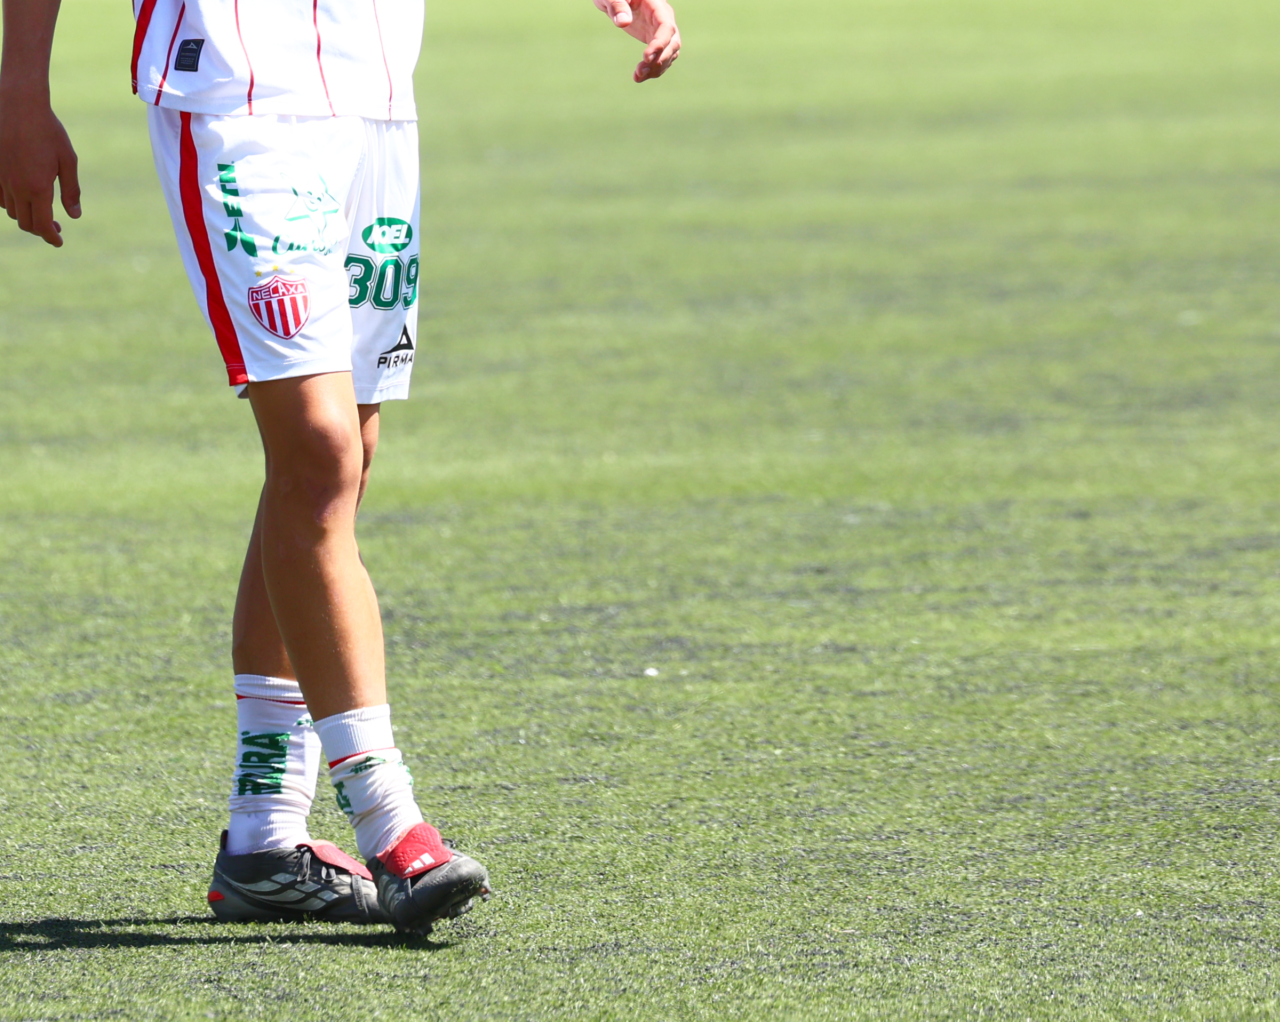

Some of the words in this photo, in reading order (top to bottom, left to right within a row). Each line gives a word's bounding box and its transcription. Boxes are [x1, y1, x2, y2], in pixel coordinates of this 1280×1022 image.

[252, 281, 307, 301] NECAXA
[344, 253, 419, 310] 309
[377, 352, 414, 369] PIRMA
